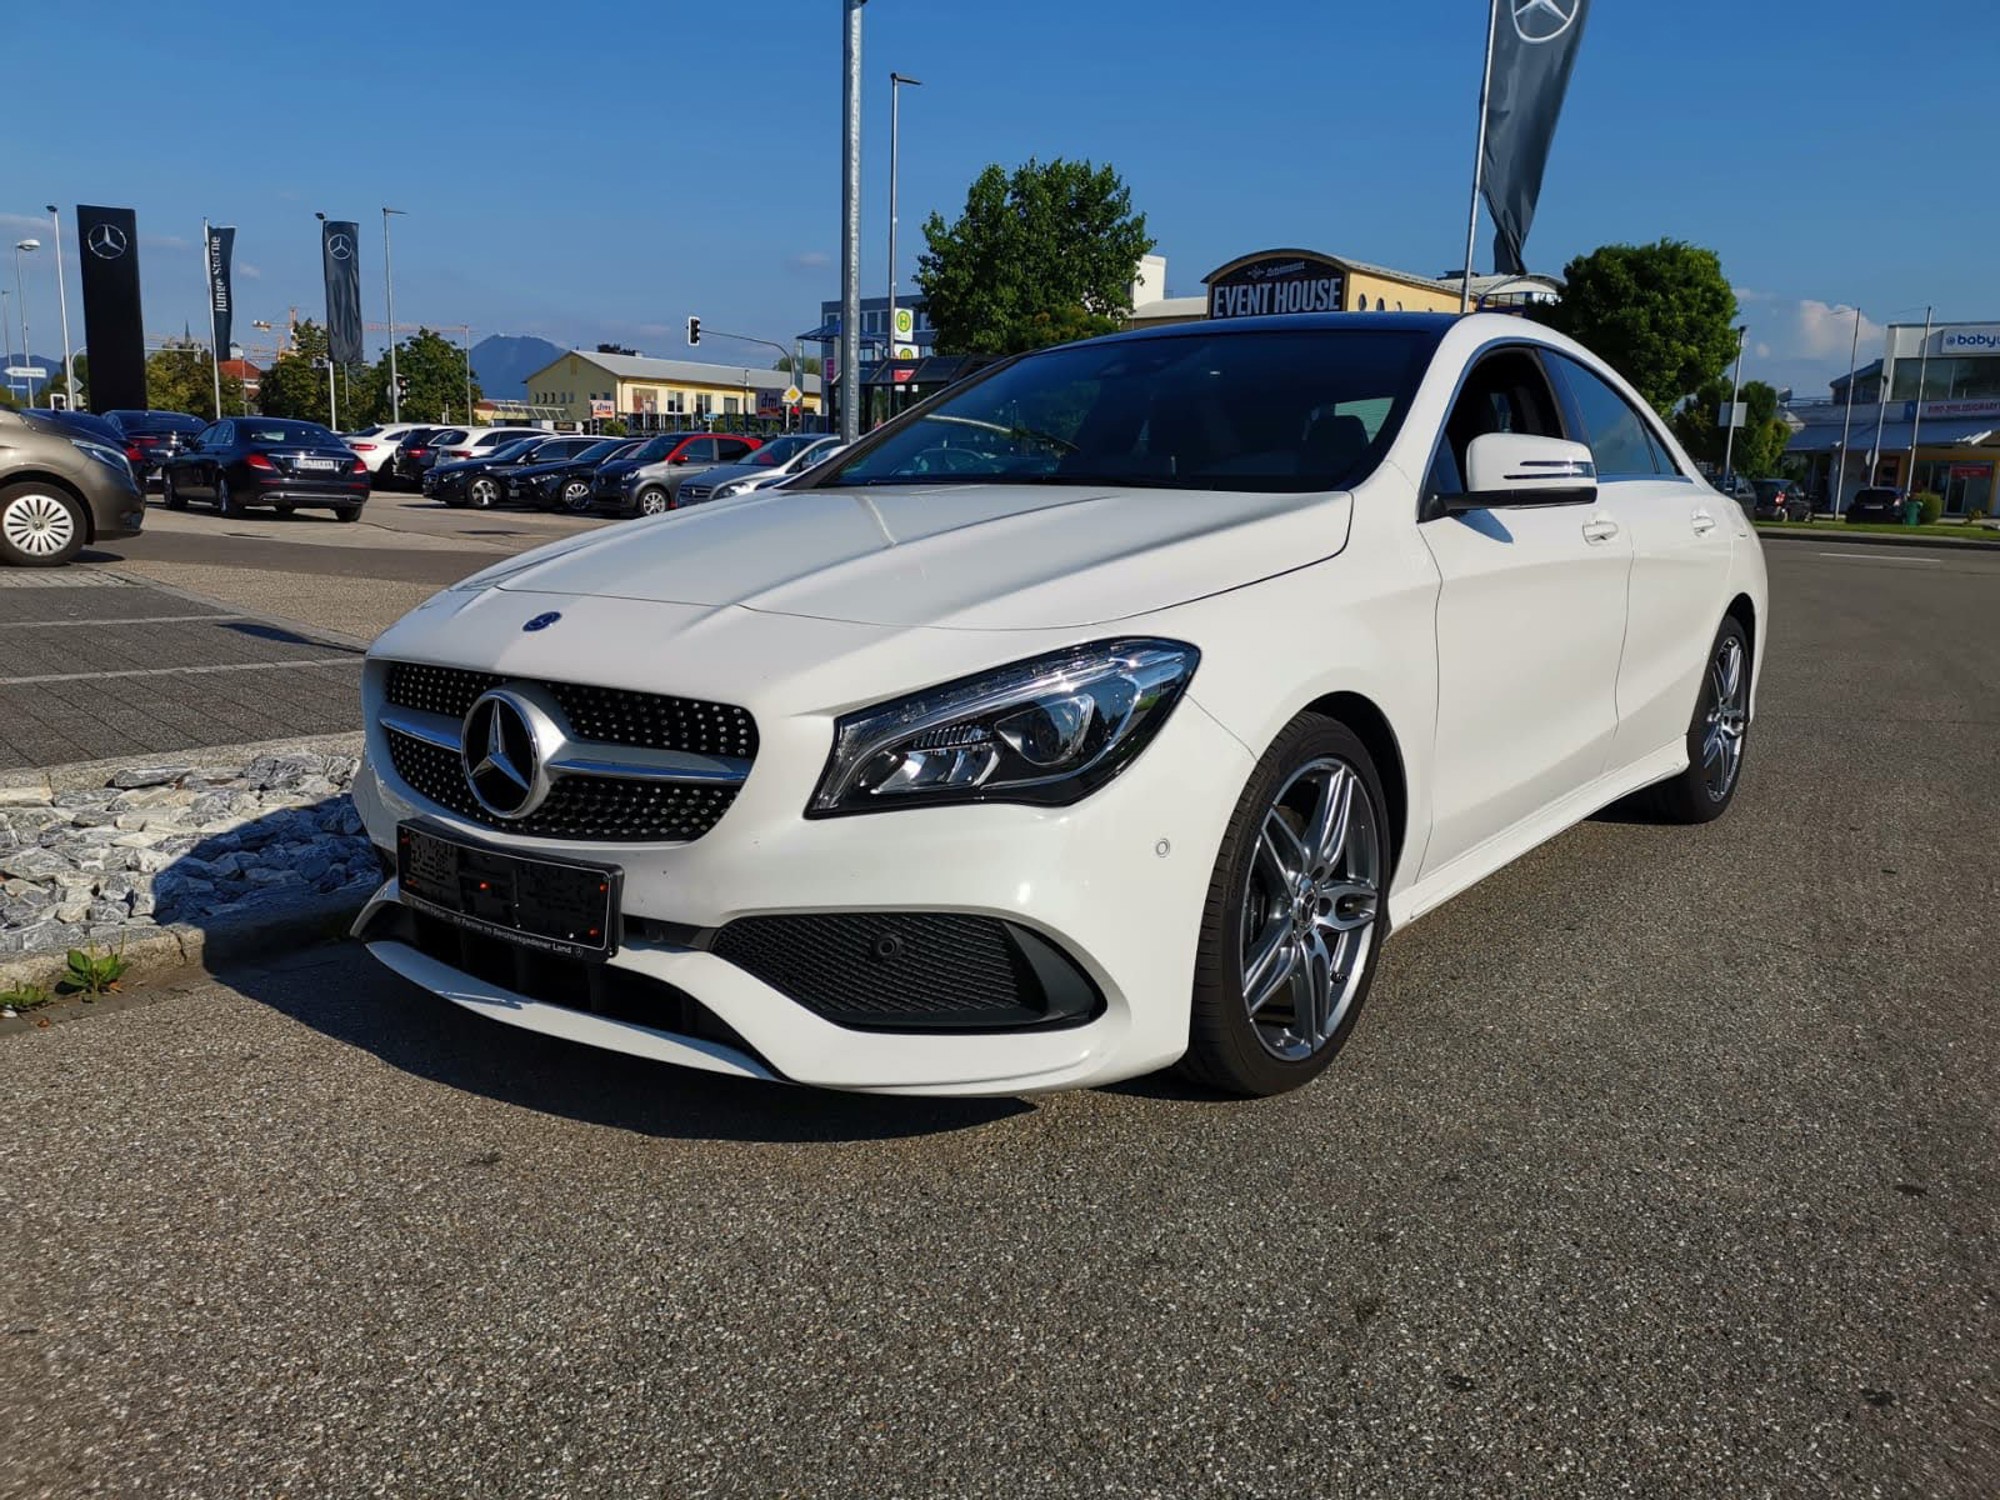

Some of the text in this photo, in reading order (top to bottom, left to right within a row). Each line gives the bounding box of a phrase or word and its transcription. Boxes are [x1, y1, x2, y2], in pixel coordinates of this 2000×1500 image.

[215, 279, 228, 312] Junge
[1213, 278, 1342, 318] EVENT HOUSE
[761, 392, 777, 408] dm
[552, 942, 572, 954] Land
